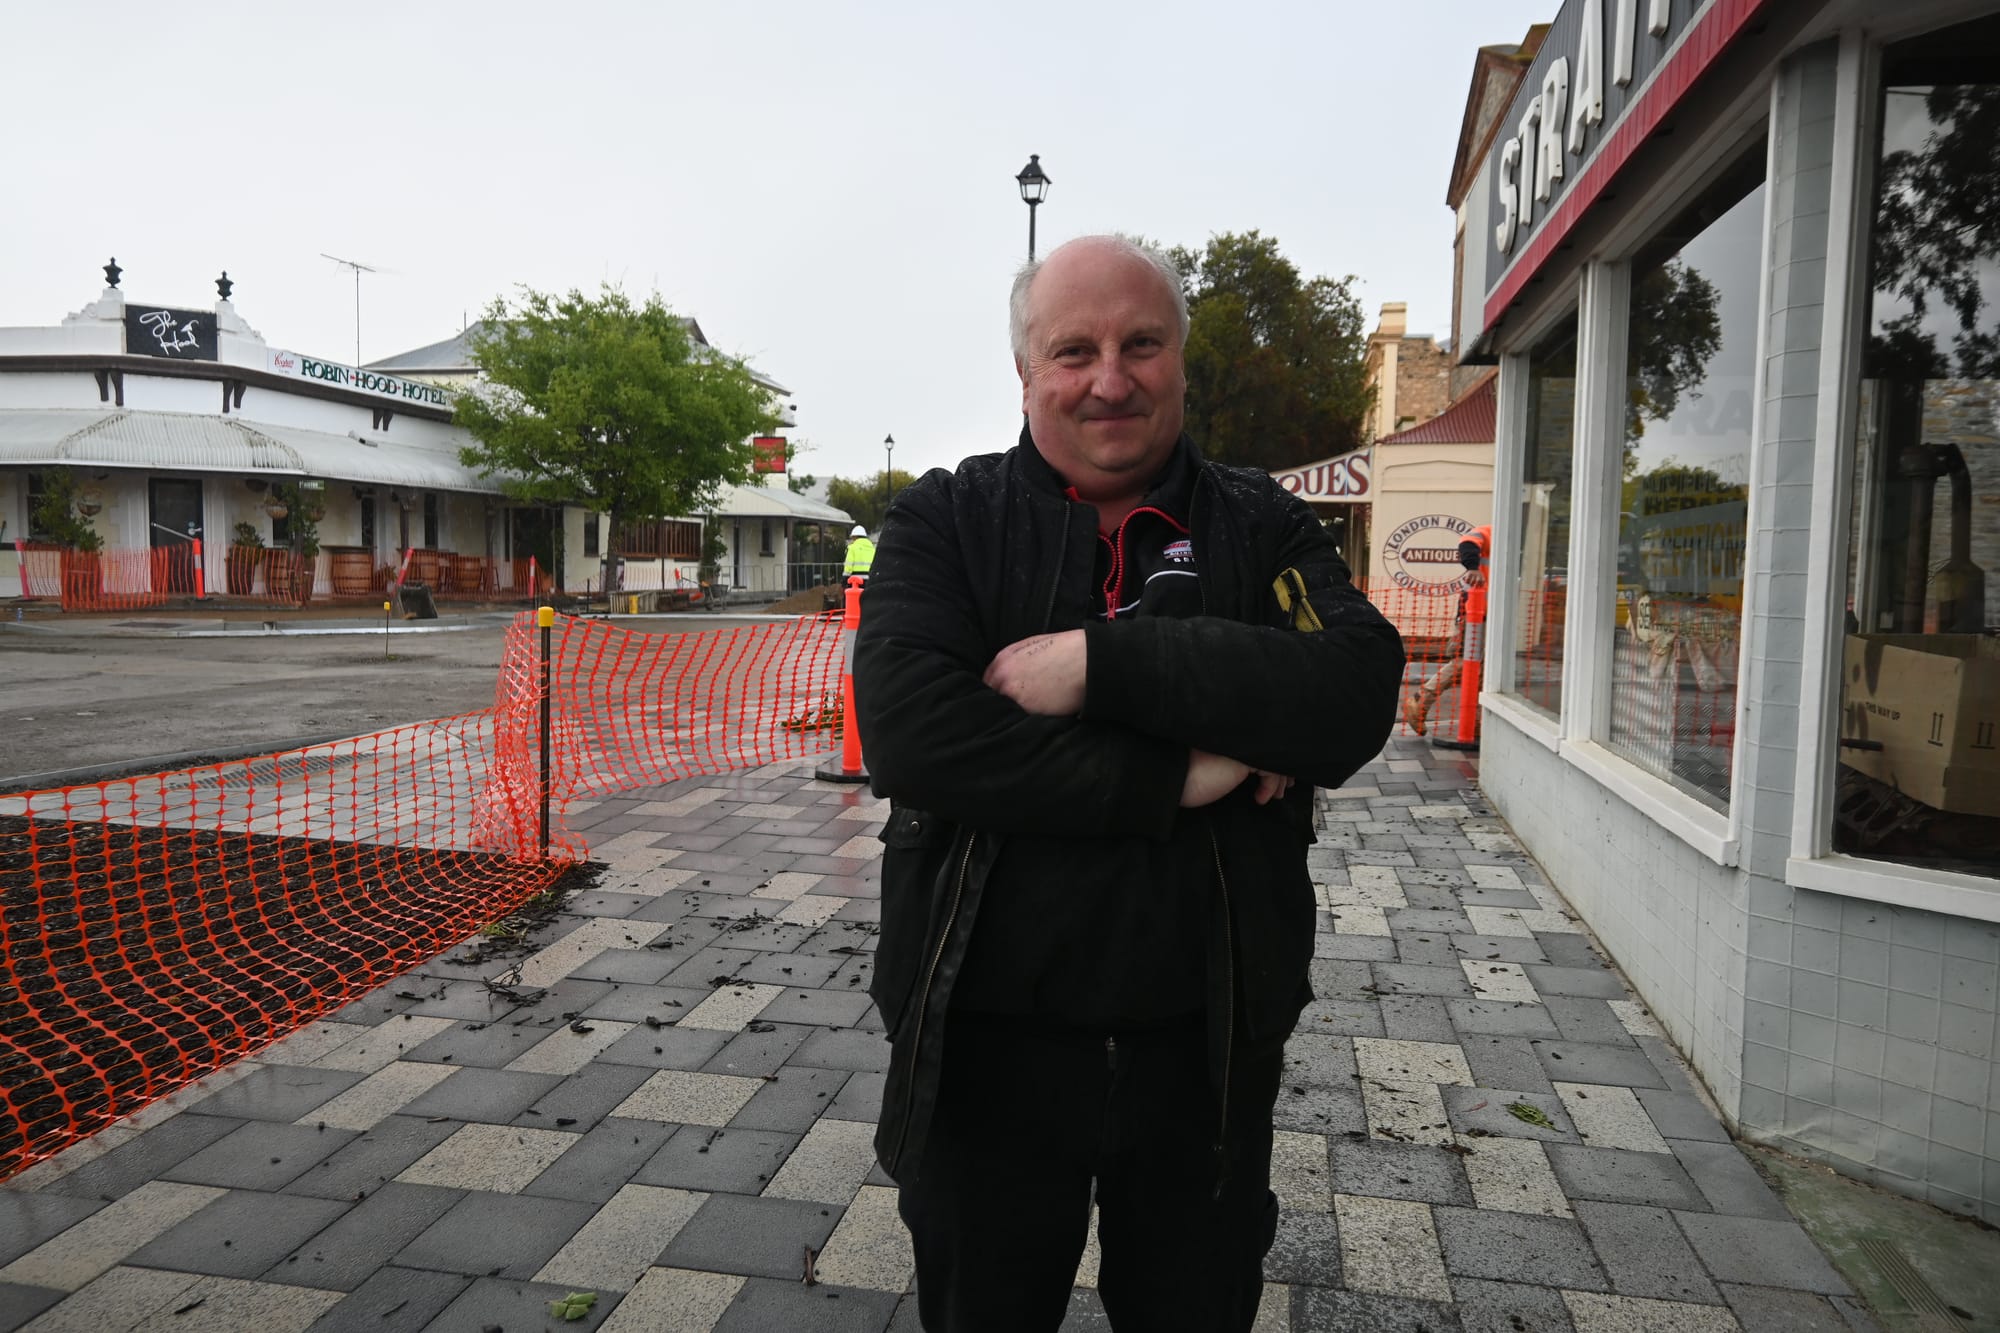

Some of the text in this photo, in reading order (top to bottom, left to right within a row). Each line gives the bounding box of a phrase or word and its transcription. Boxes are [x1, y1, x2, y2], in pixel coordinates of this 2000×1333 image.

[1496, 0, 1670, 256] STRA
[139, 310, 177, 338] The
[301, 358, 447, 406] ROBIN HOOD HOTEL
[1387, 516, 1473, 550] LONDON HO
